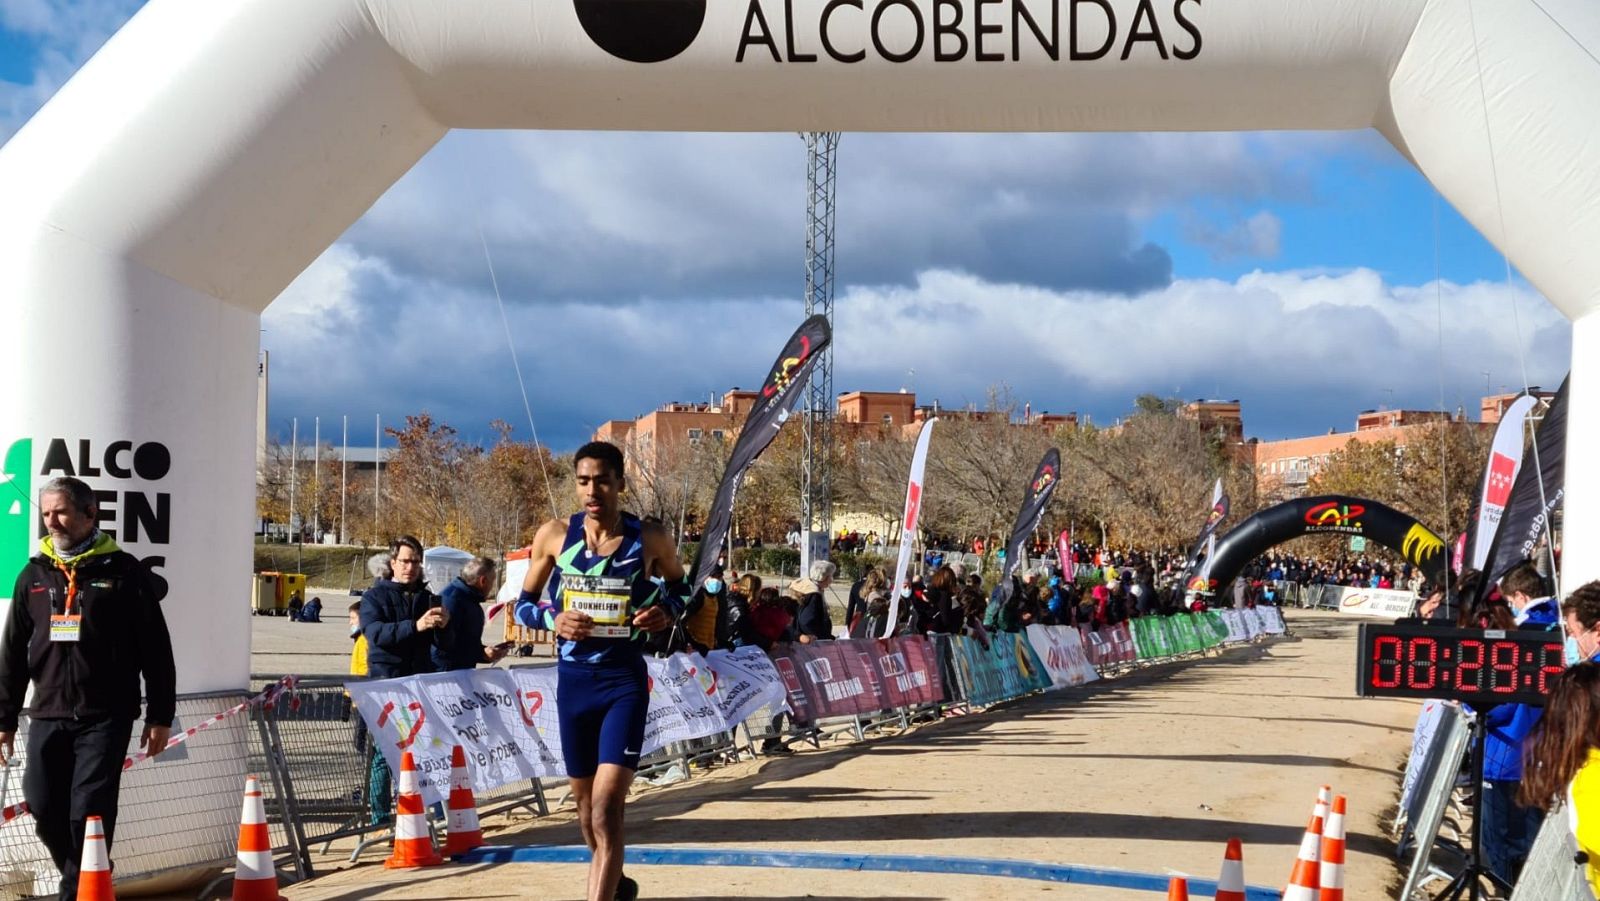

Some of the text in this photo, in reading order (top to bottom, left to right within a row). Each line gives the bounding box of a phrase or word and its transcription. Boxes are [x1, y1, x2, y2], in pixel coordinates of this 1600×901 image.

[735, 0, 1203, 63] ALCOBENDAS
[40, 438, 171, 481] ALCO
[38, 488, 171, 544] EN
[1305, 525, 1363, 533] ALCOBENDAS
